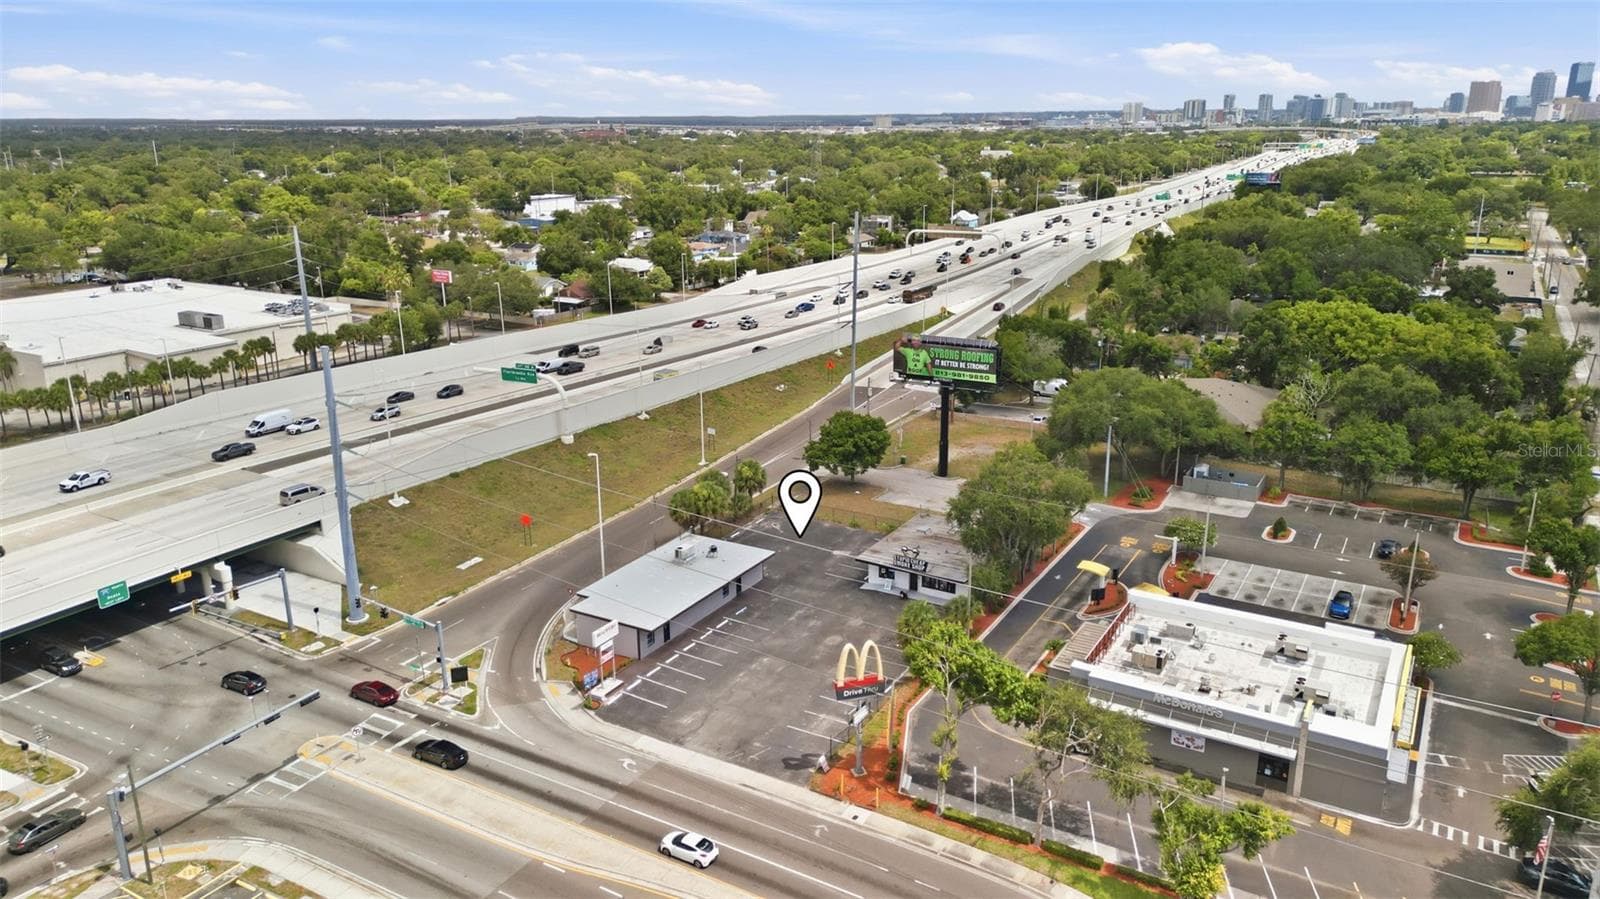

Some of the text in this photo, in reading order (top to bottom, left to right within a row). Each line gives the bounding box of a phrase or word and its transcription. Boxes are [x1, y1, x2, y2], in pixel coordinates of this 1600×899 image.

[930, 348, 994, 364] STRONG ROOFING
[940, 360, 959, 368] BETTER
[843, 689, 863, 697] Drive
[1153, 693, 1224, 719] McDonald's
